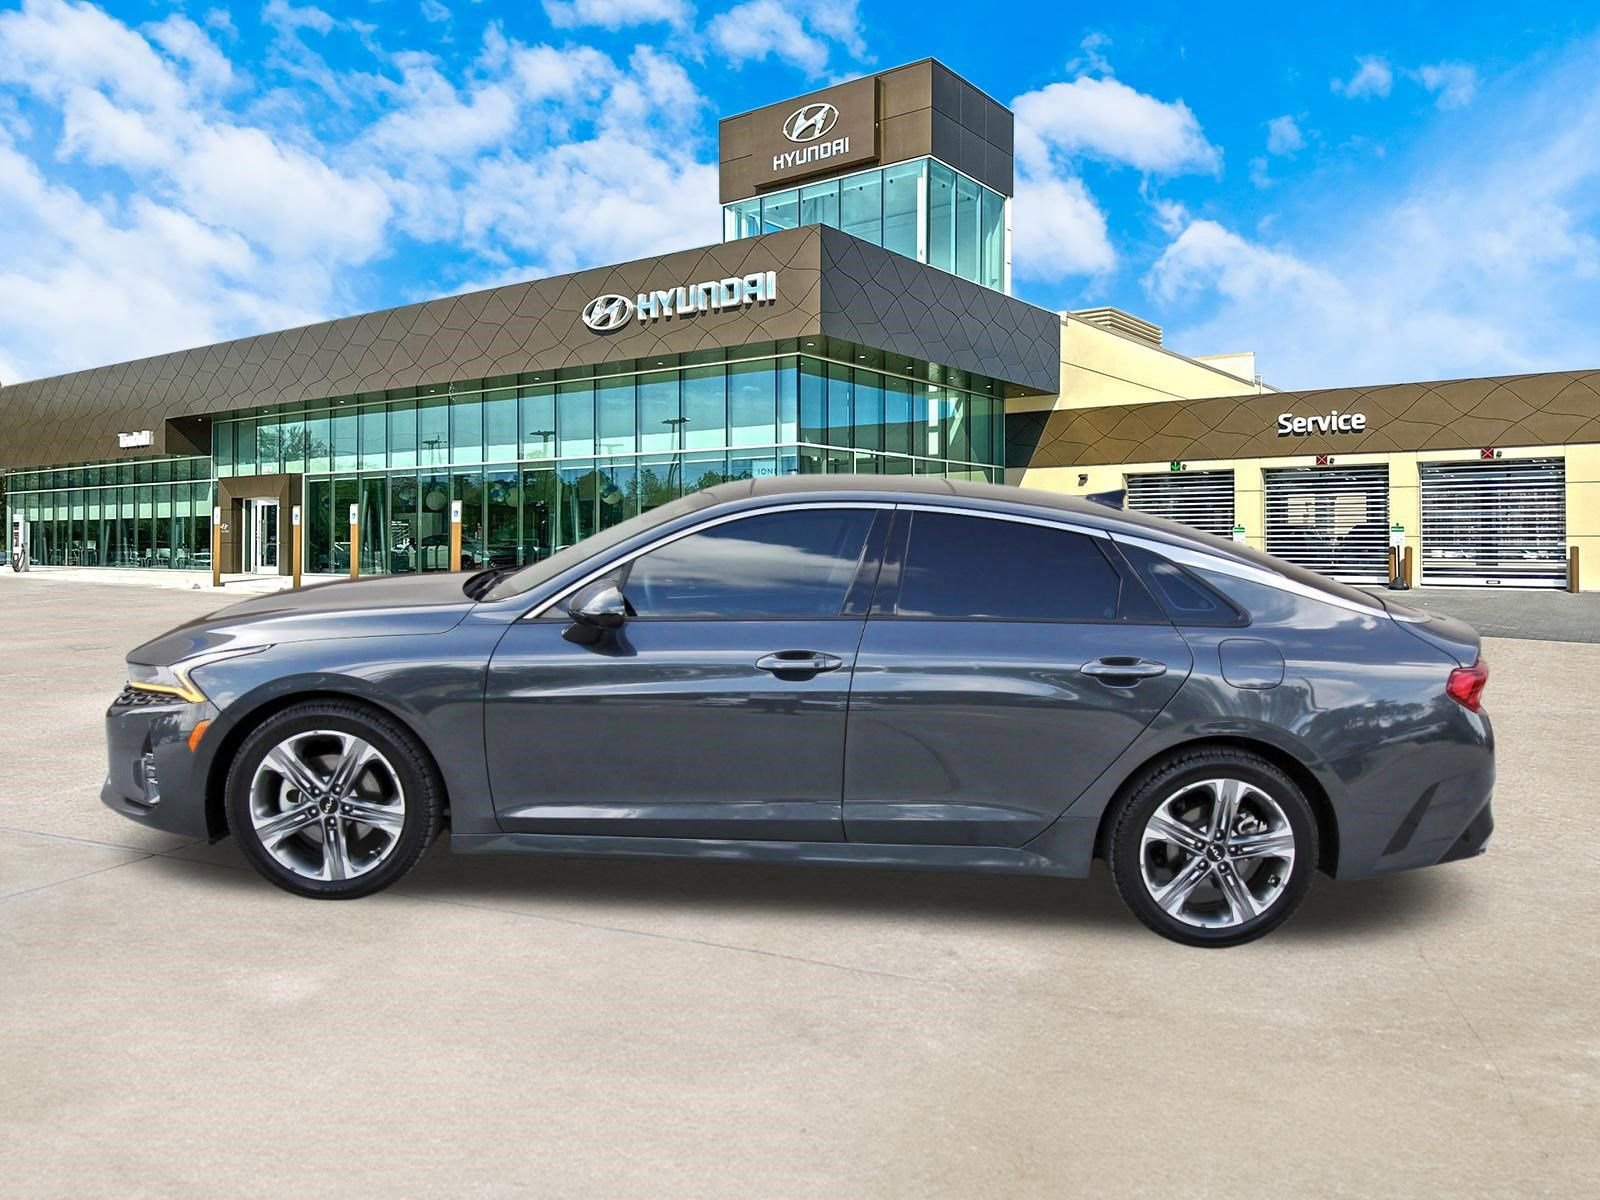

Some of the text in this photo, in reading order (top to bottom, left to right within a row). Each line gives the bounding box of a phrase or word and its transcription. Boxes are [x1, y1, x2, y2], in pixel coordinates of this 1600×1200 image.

[773, 136, 850, 171] HYUNDAI
[636, 271, 777, 321] HYUNDAI
[1277, 410, 1367, 435] Service
